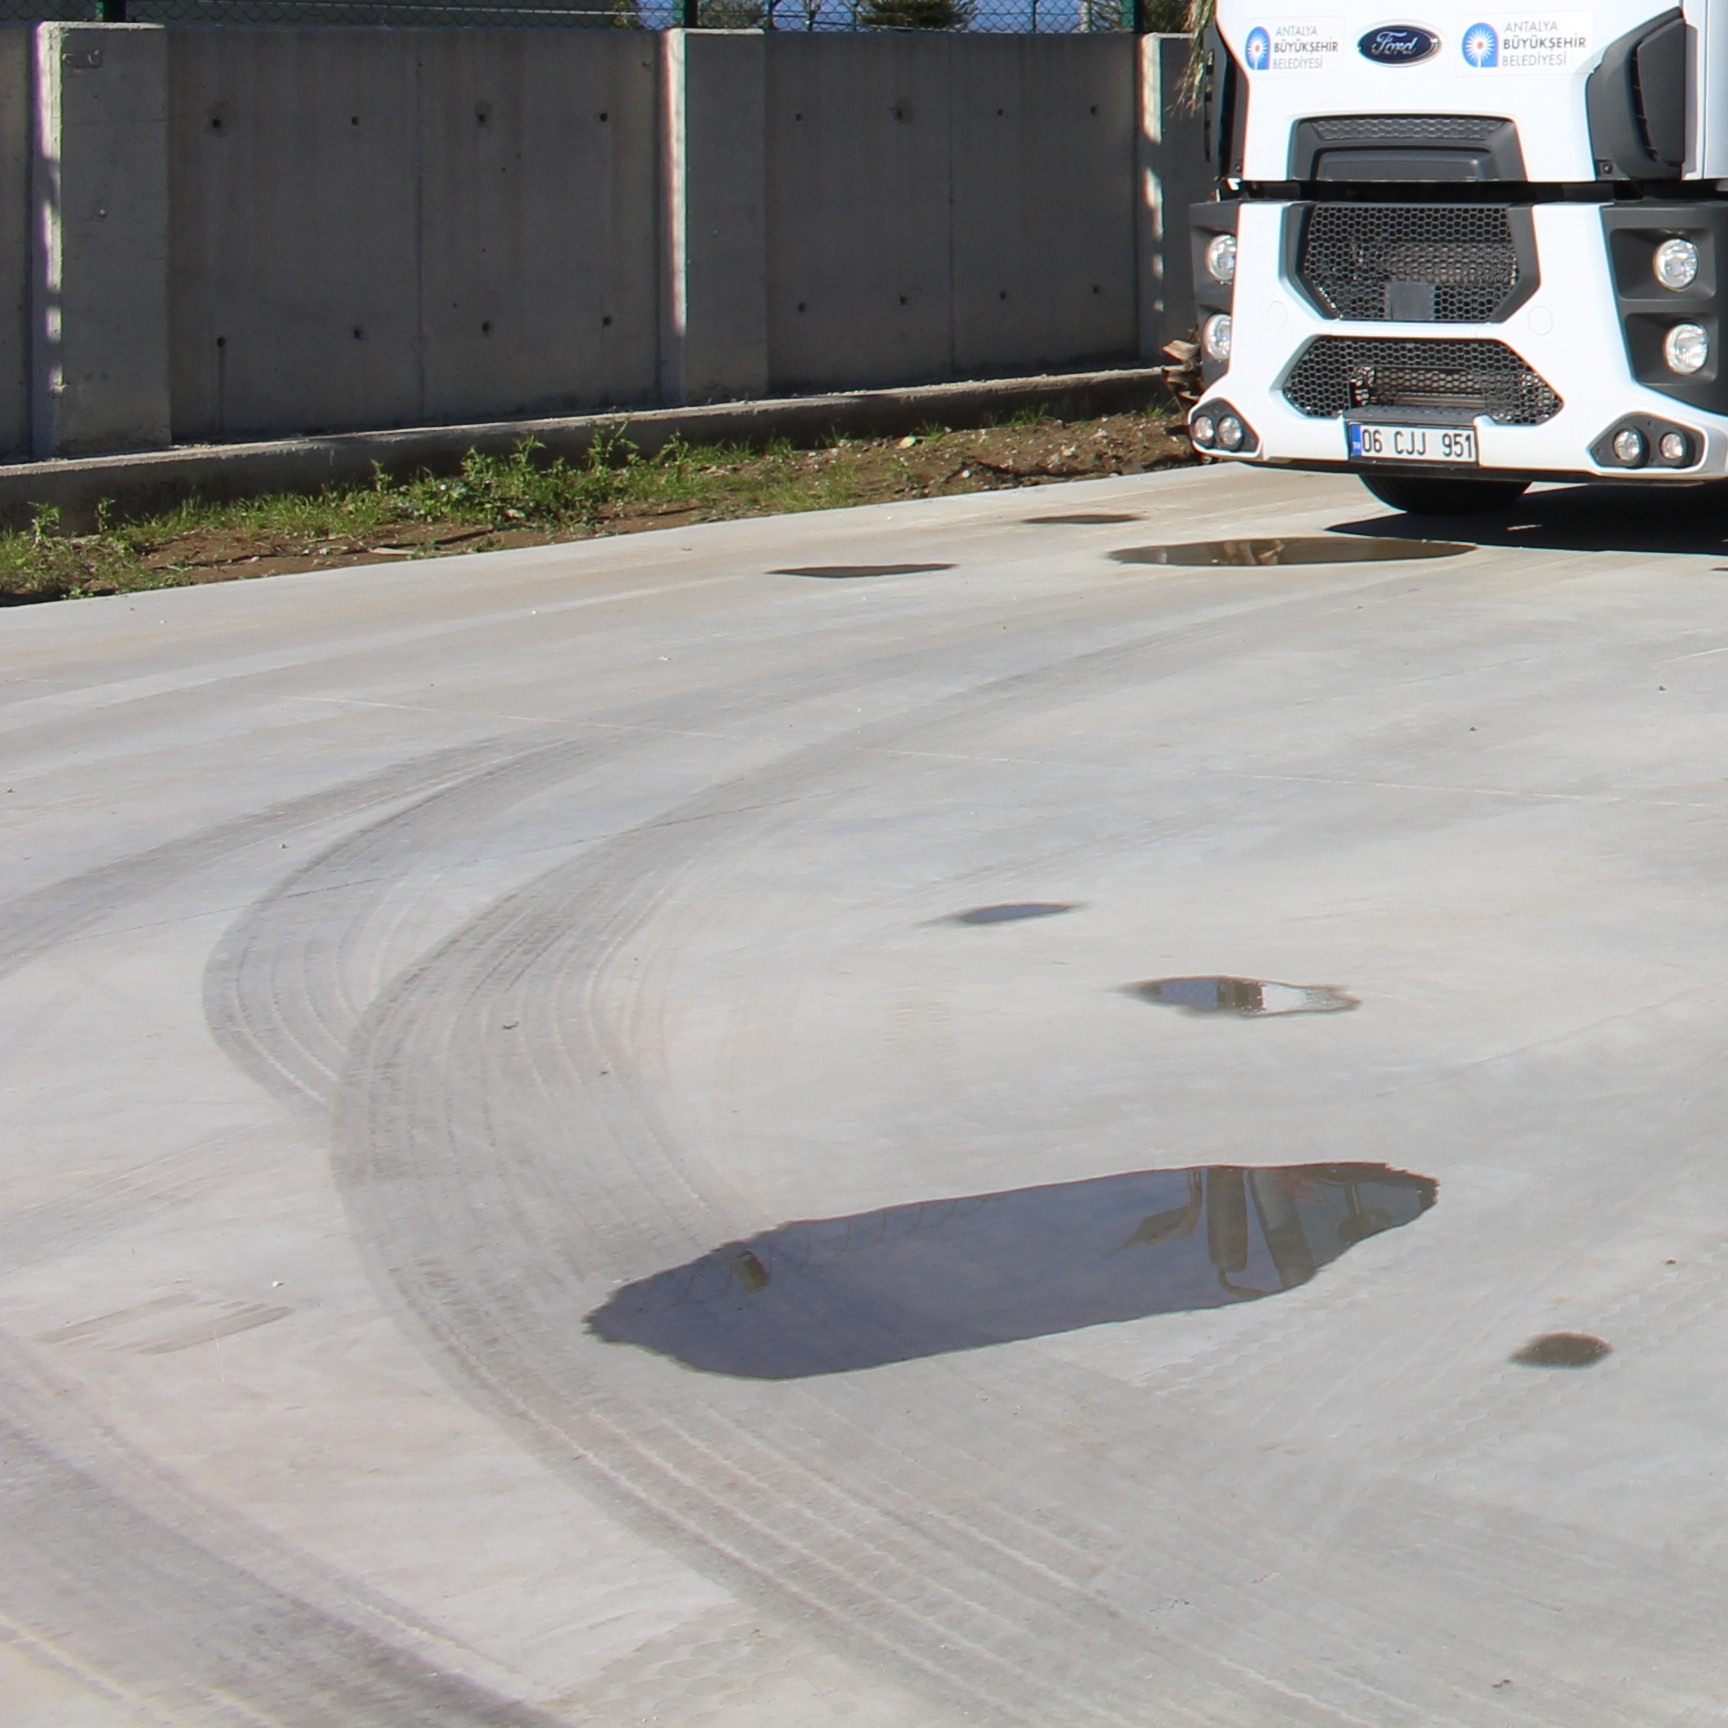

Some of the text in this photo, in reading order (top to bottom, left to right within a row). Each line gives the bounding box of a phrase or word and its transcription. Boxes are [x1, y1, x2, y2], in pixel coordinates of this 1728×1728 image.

[1275, 25, 1319, 37] ANTALYA
[1504, 20, 1559, 33] ANTALYA
[1273, 37, 1339, 55] BÜYÜKŞEHİR
[1371, 31, 1420, 55] Ford
[1503, 33, 1587, 52] BÜYÜKŞEHİR
[1272, 55, 1324, 70] BELEDİYESİ
[1502, 51, 1568, 68] BELEDİYESİ
[1362, 429, 1473, 459] 06 CJJ 951
